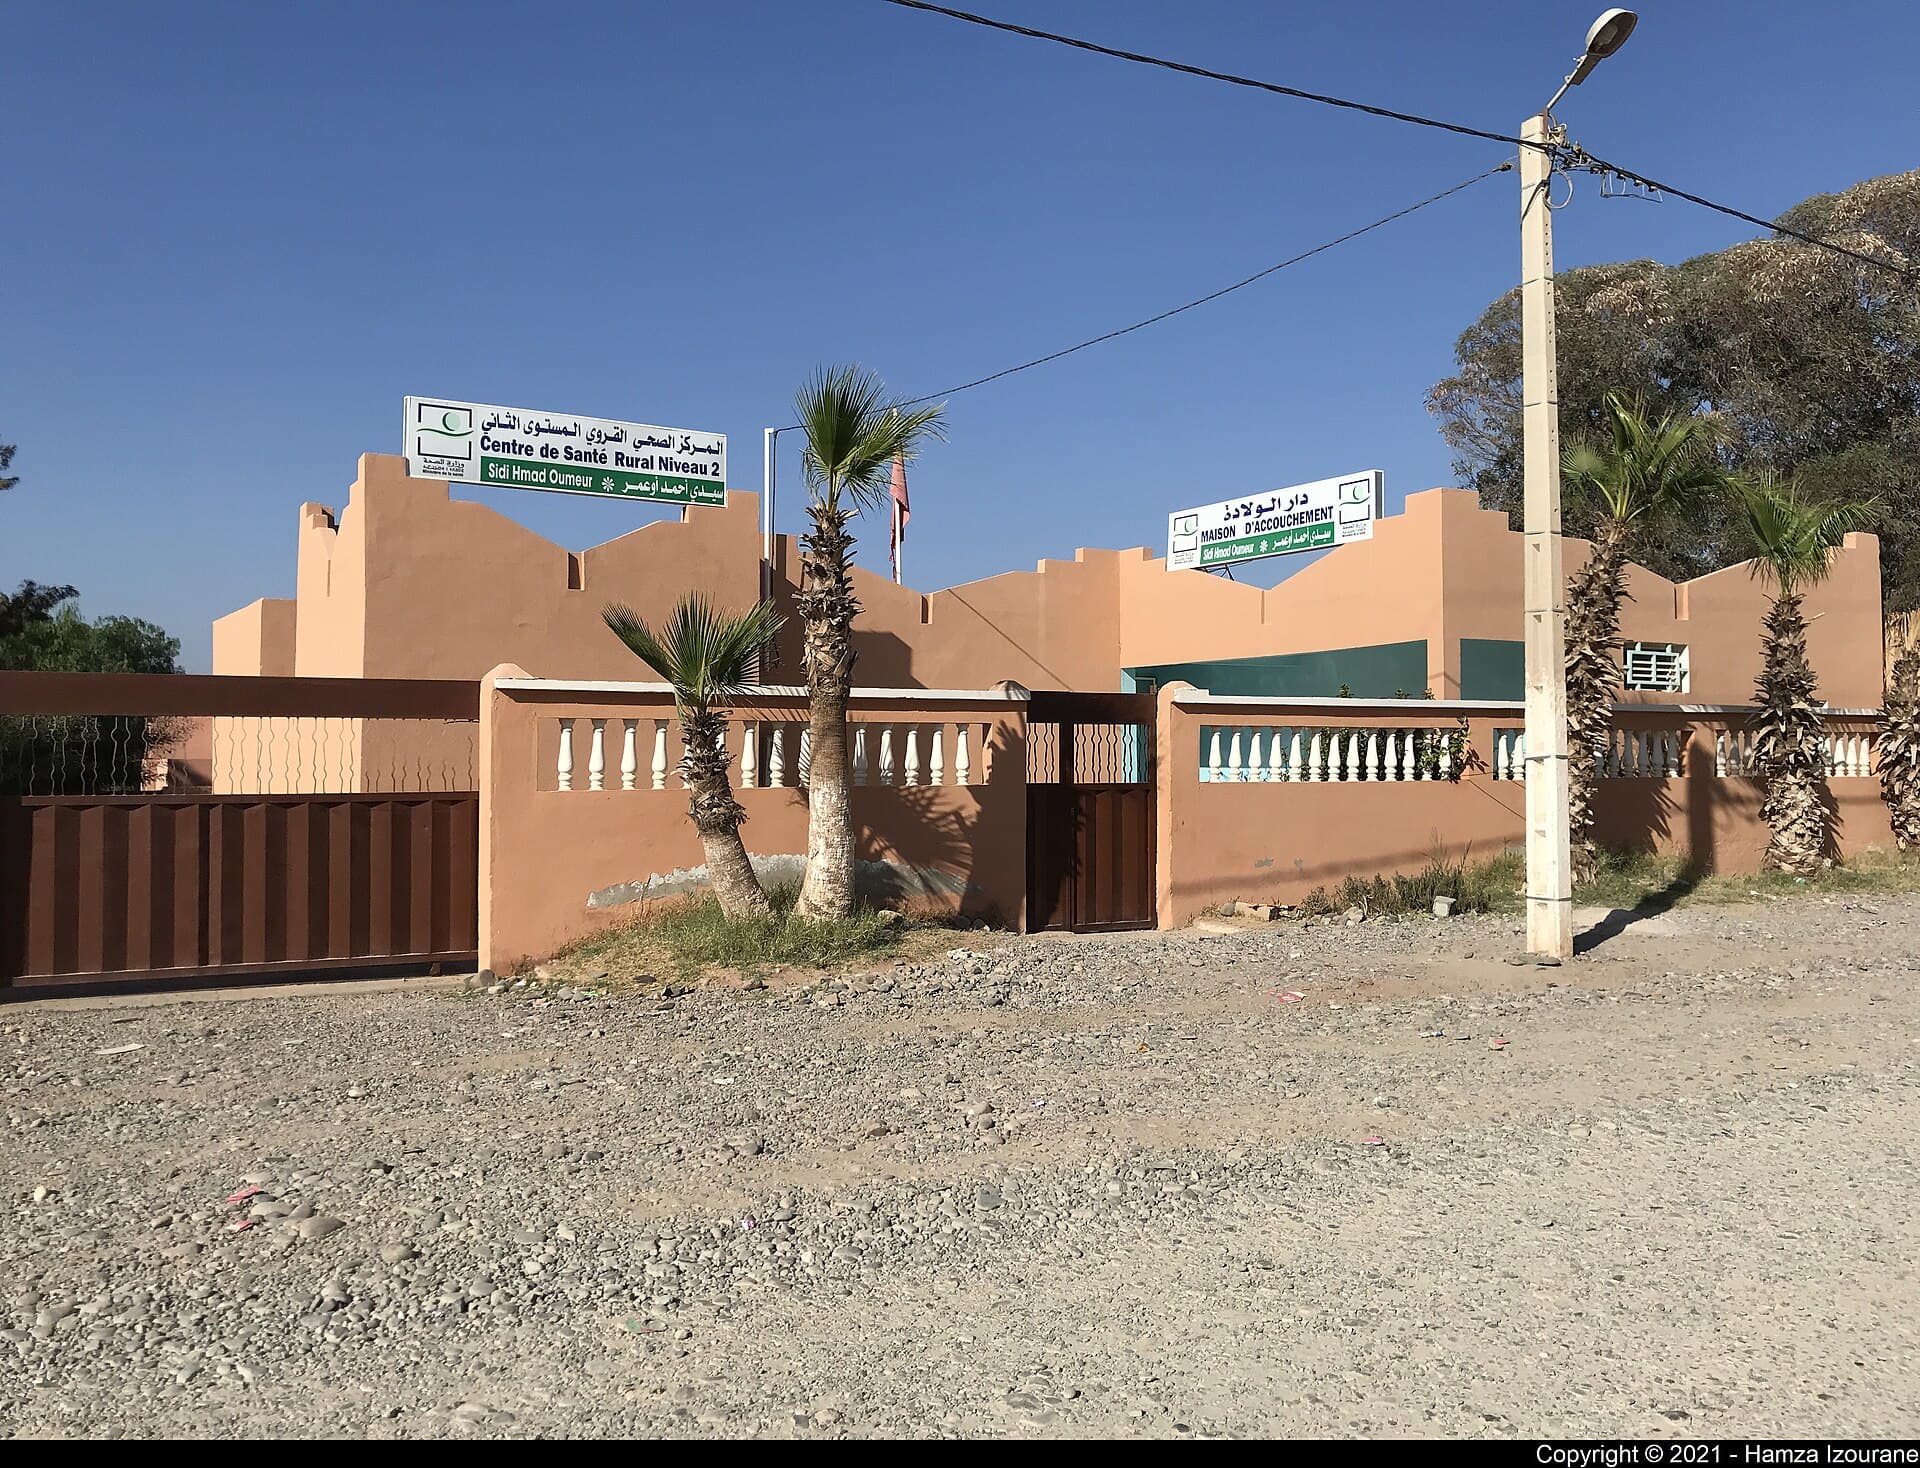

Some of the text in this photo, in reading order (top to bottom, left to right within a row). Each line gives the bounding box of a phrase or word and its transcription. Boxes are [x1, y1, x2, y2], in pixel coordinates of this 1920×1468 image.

[586, 426, 627, 446] القروي
[633, 434, 675, 451] الصحي
[480, 435, 720, 477] Centre de Santé Rural Niveau 2
[488, 462, 593, 488] Sidi Hmad Oumeur
[660, 478, 688, 495] أحمد
[690, 484, 724, 502] سيدي
[1224, 493, 1308, 521] دار الولادة
[1201, 525, 1236, 543] MAISON
[1245, 505, 1334, 534] D'ACCOUCHEMENT
